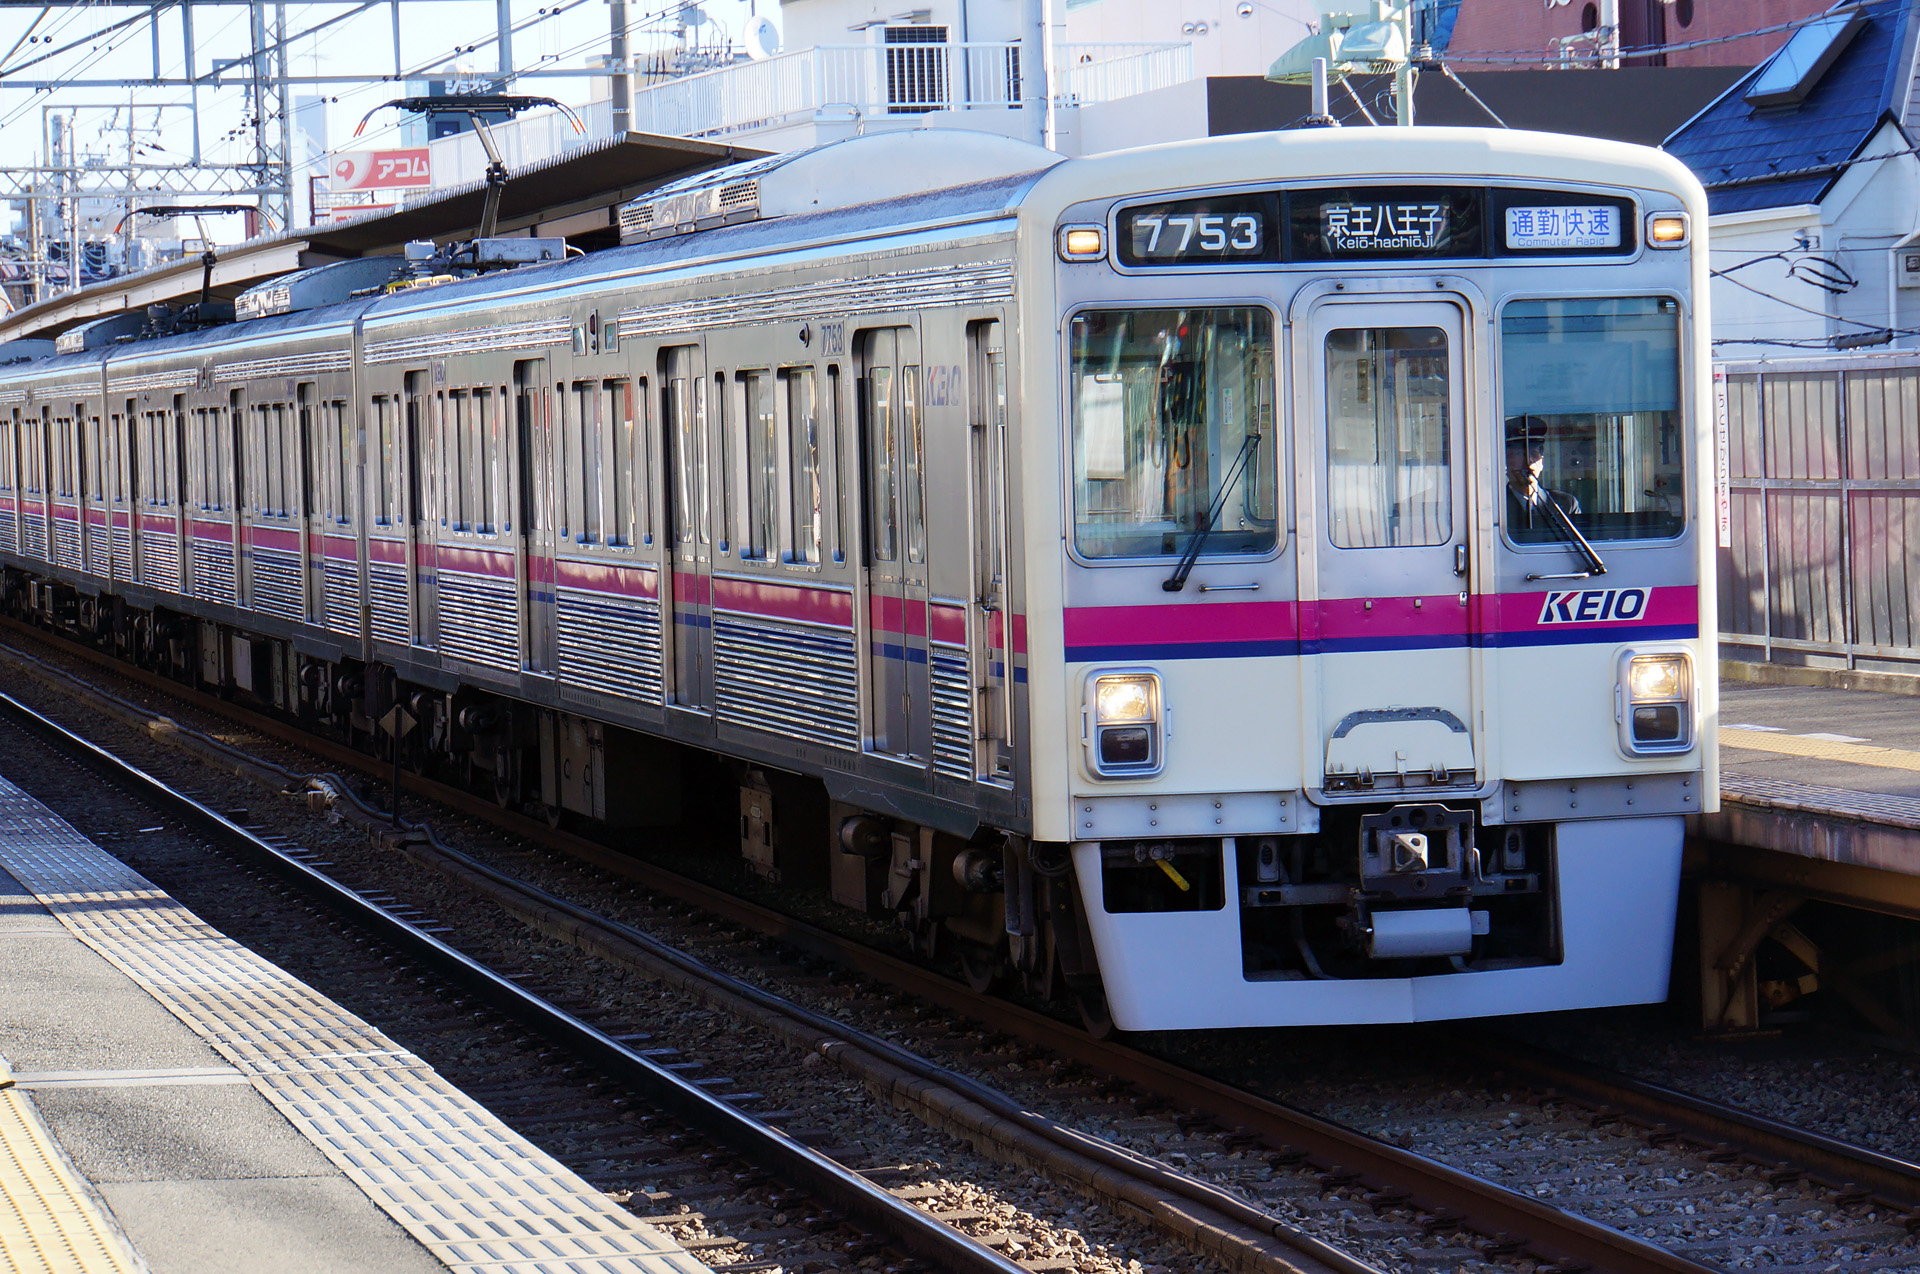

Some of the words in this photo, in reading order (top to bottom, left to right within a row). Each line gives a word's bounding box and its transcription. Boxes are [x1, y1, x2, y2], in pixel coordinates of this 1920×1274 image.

[378, 157, 429, 180] アコム
[1136, 216, 1257, 252] 7753
[1326, 205, 1443, 238] 京王八王子
[1512, 208, 1610, 237] 通勤快速
[1518, 237, 1572, 247] Commuter
[1576, 236, 1605, 246] Rapid
[821, 324, 843, 355] 7753
[926, 365, 961, 406] KEIO
[1543, 588, 1645, 622] KEIO
